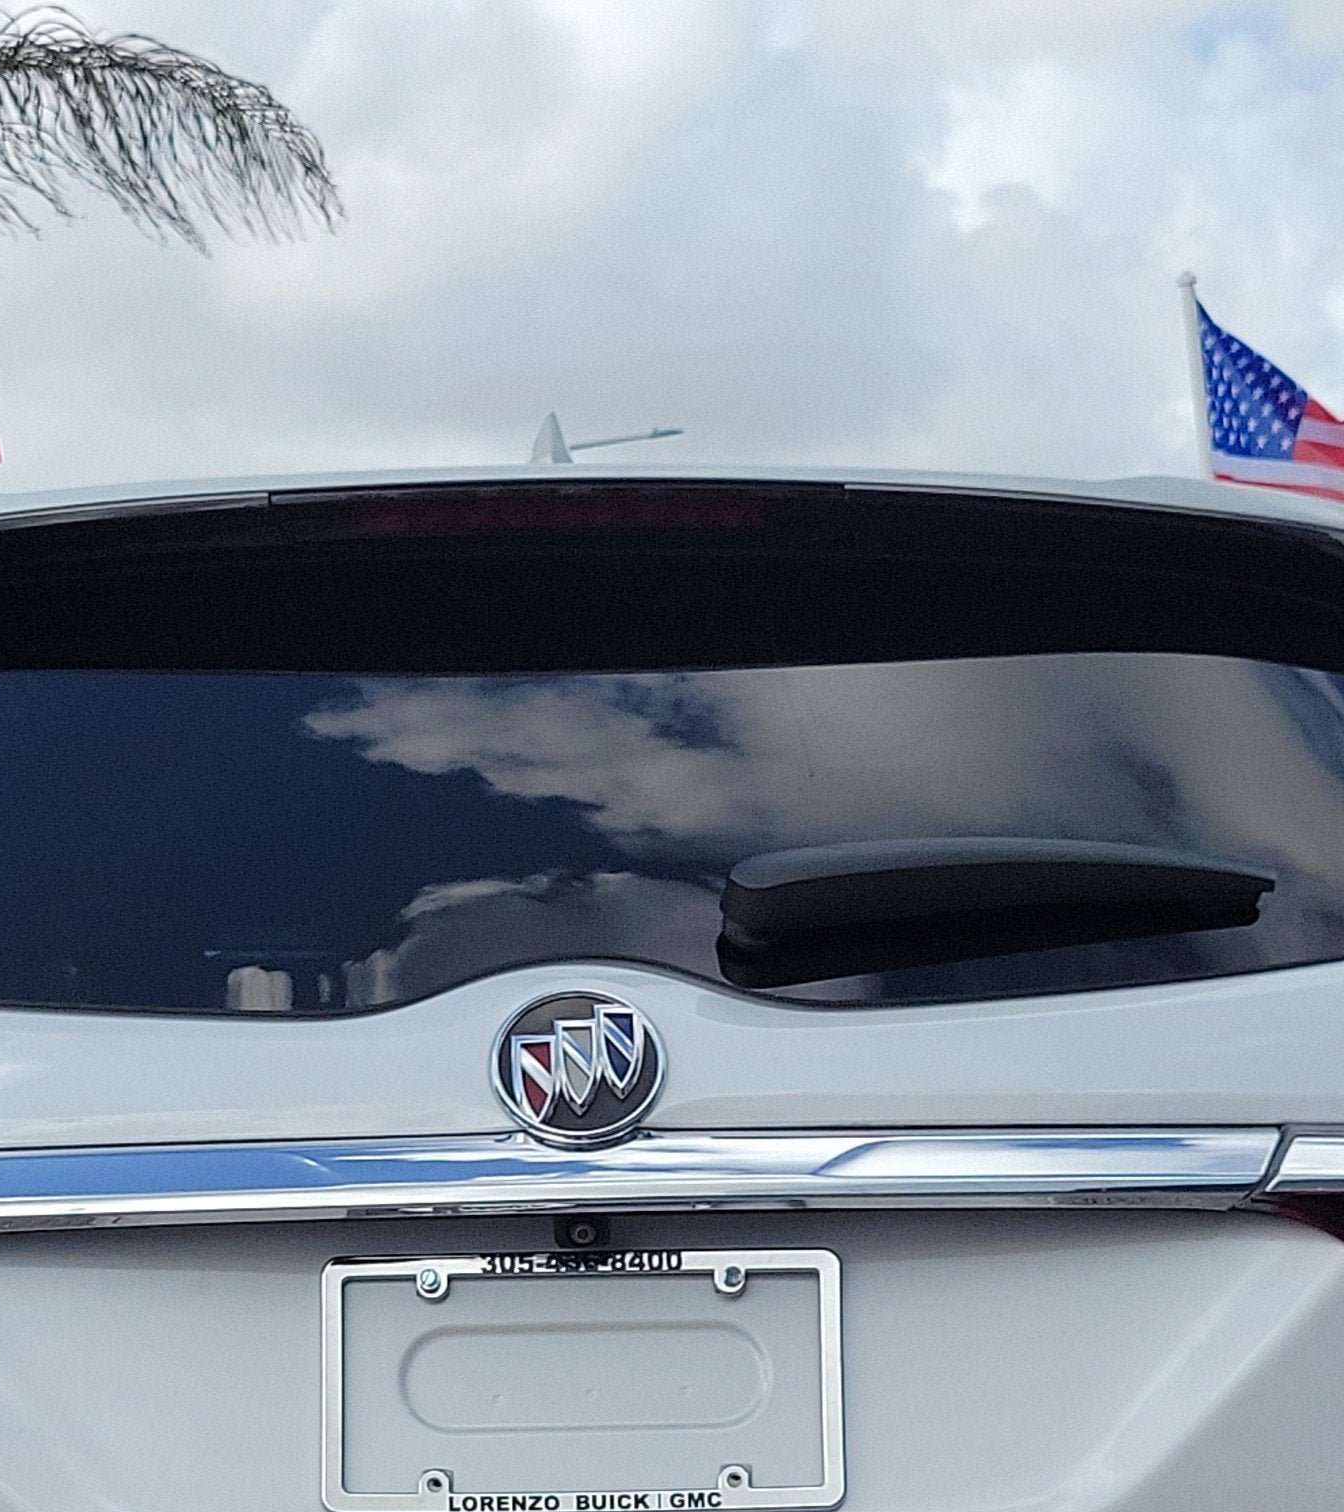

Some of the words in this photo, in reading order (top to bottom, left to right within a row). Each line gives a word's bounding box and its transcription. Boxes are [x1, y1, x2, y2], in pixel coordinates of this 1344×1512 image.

[448, 1495, 560, 1512] LORENZO
[576, 1493, 649, 1511] BUICK
[670, 1491, 723, 1509] GMC
